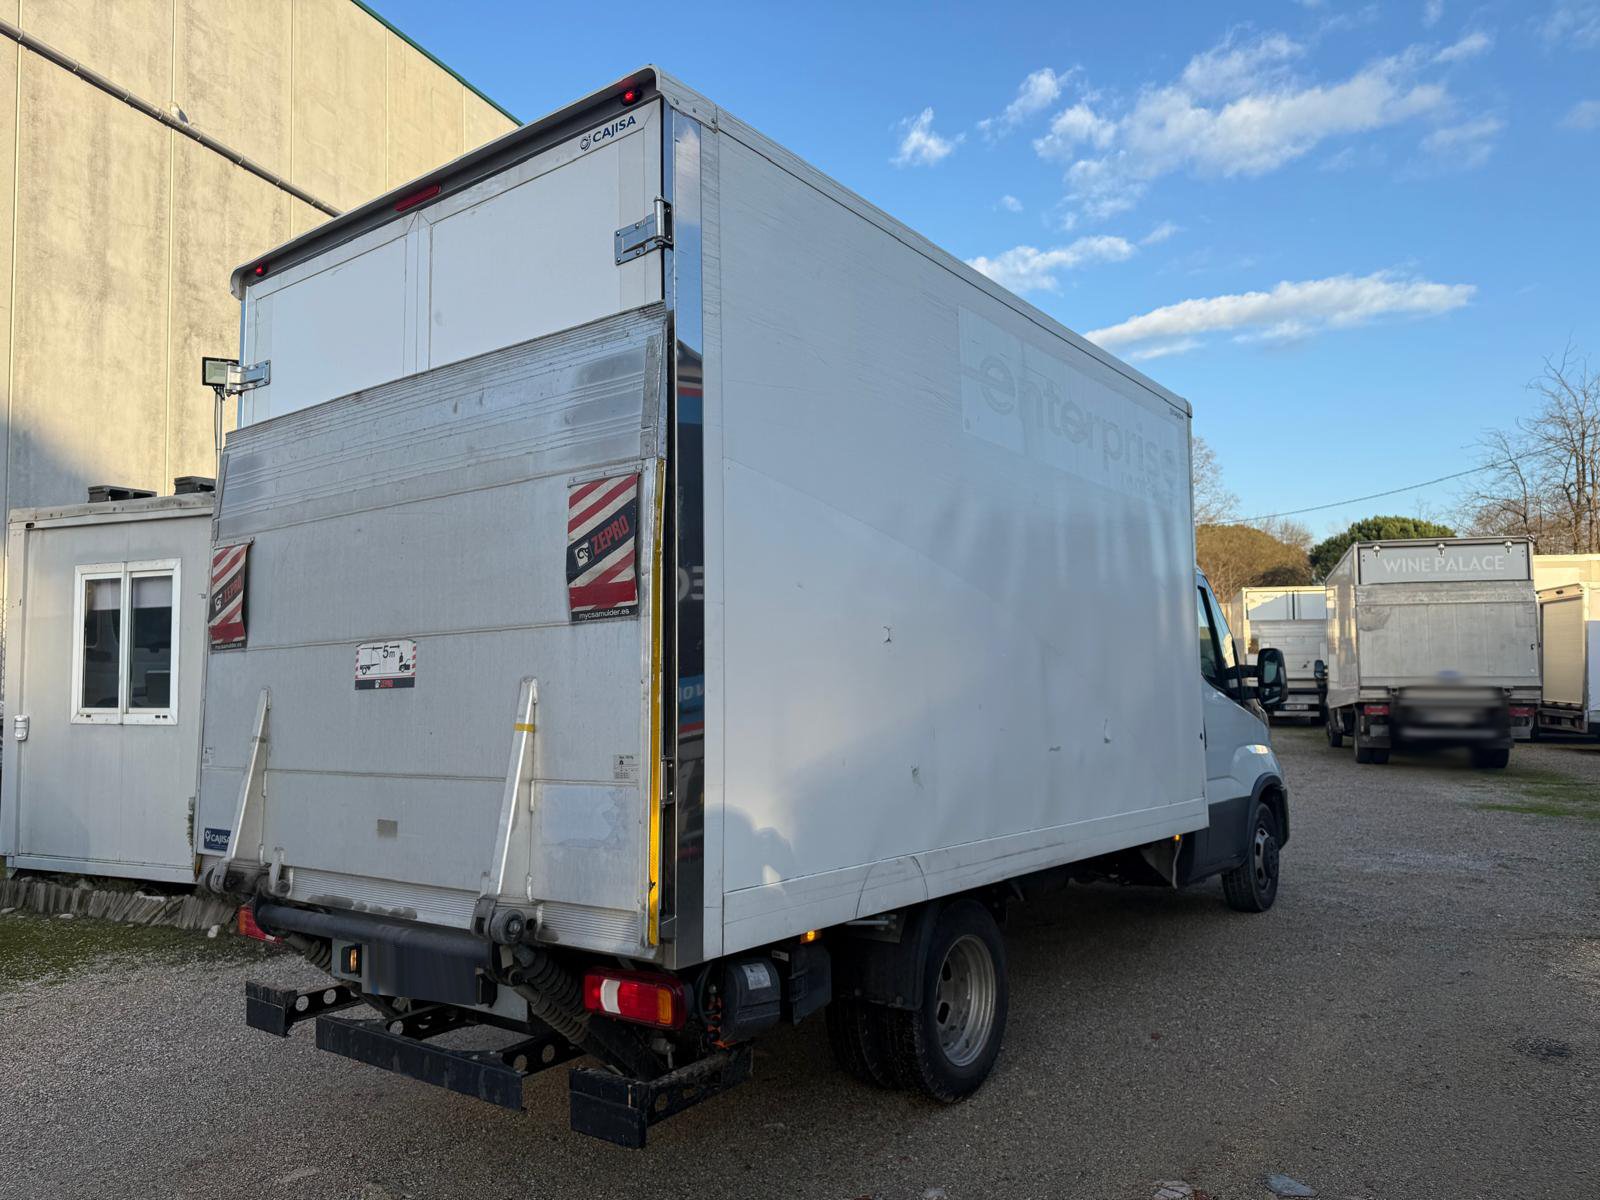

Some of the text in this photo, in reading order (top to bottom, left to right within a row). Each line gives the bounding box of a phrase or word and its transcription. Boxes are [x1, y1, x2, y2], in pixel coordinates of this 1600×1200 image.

[592, 115, 636, 142] CAJISA
[979, 354, 1176, 480] enterprise
[591, 514, 630, 557] ZEPRO
[1383, 555, 1505, 574] WINE PALACE
